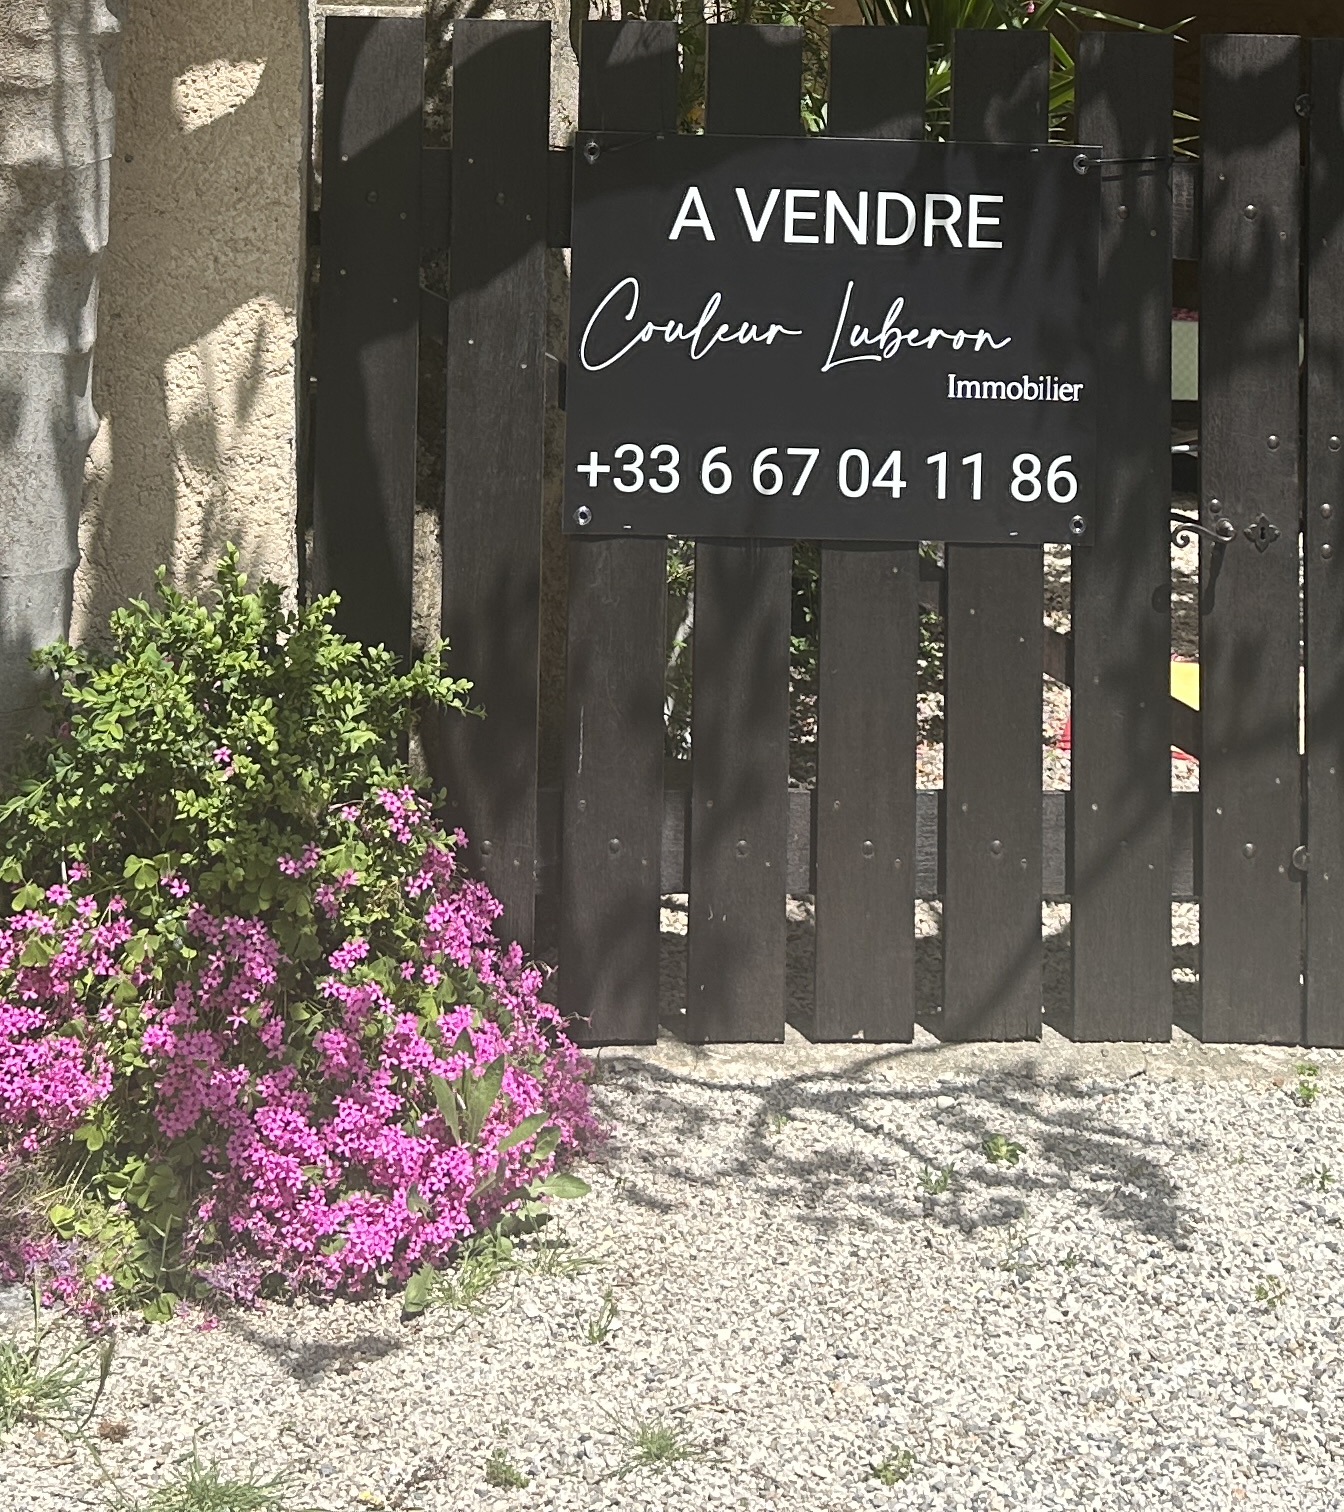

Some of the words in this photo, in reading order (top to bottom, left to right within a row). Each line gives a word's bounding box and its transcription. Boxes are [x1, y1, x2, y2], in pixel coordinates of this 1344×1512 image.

[668, 186, 716, 241] A
[735, 187, 1004, 249] VENDRE
[580, 277, 803, 371] Couleur
[820, 280, 1012, 373] Luberon
[947, 374, 1084, 402] Immobilier
[576, 443, 680, 494] +33
[701, 446, 733, 495] 6
[752, 447, 820, 496] 67
[838, 448, 907, 499] 04
[926, 451, 982, 501] 11
[1010, 453, 1078, 504] 86
